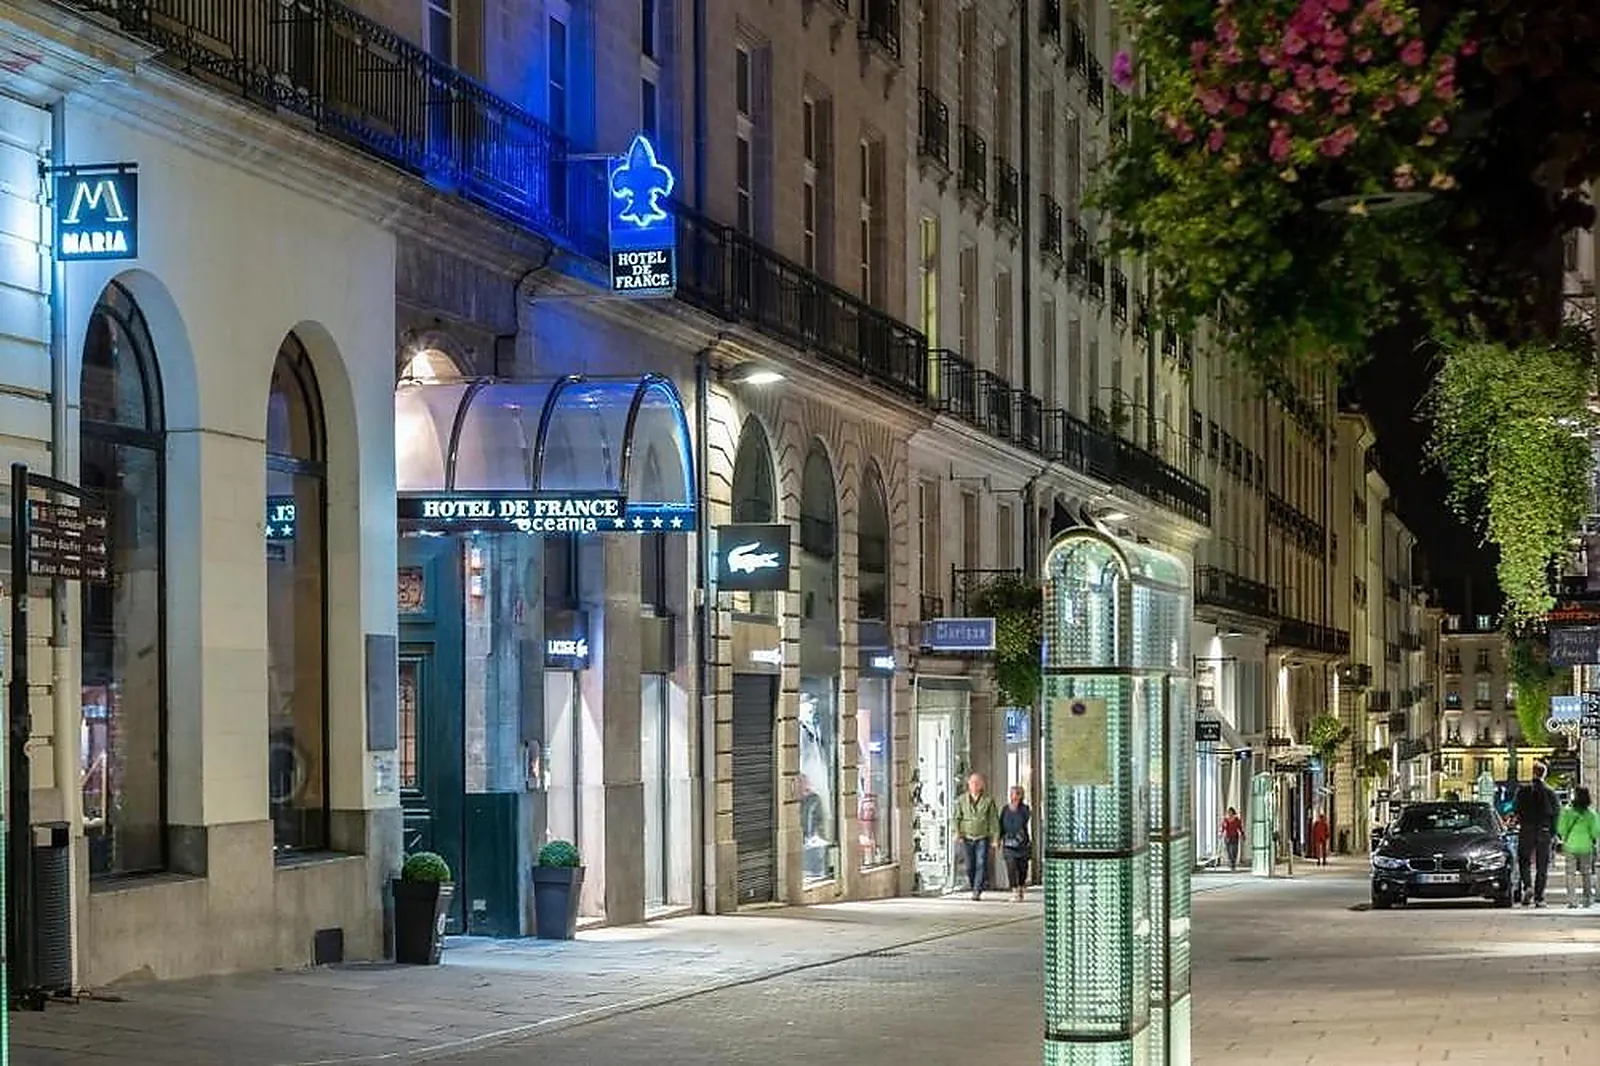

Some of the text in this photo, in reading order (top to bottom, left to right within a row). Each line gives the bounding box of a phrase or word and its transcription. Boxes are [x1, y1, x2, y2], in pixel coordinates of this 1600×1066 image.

[62, 229, 128, 254] MARIA
[618, 251, 667, 266] HOTEL
[632, 264, 653, 276] DE
[615, 273, 670, 289] FRANCE
[423, 499, 619, 518] HOTEL DE FRANCE
